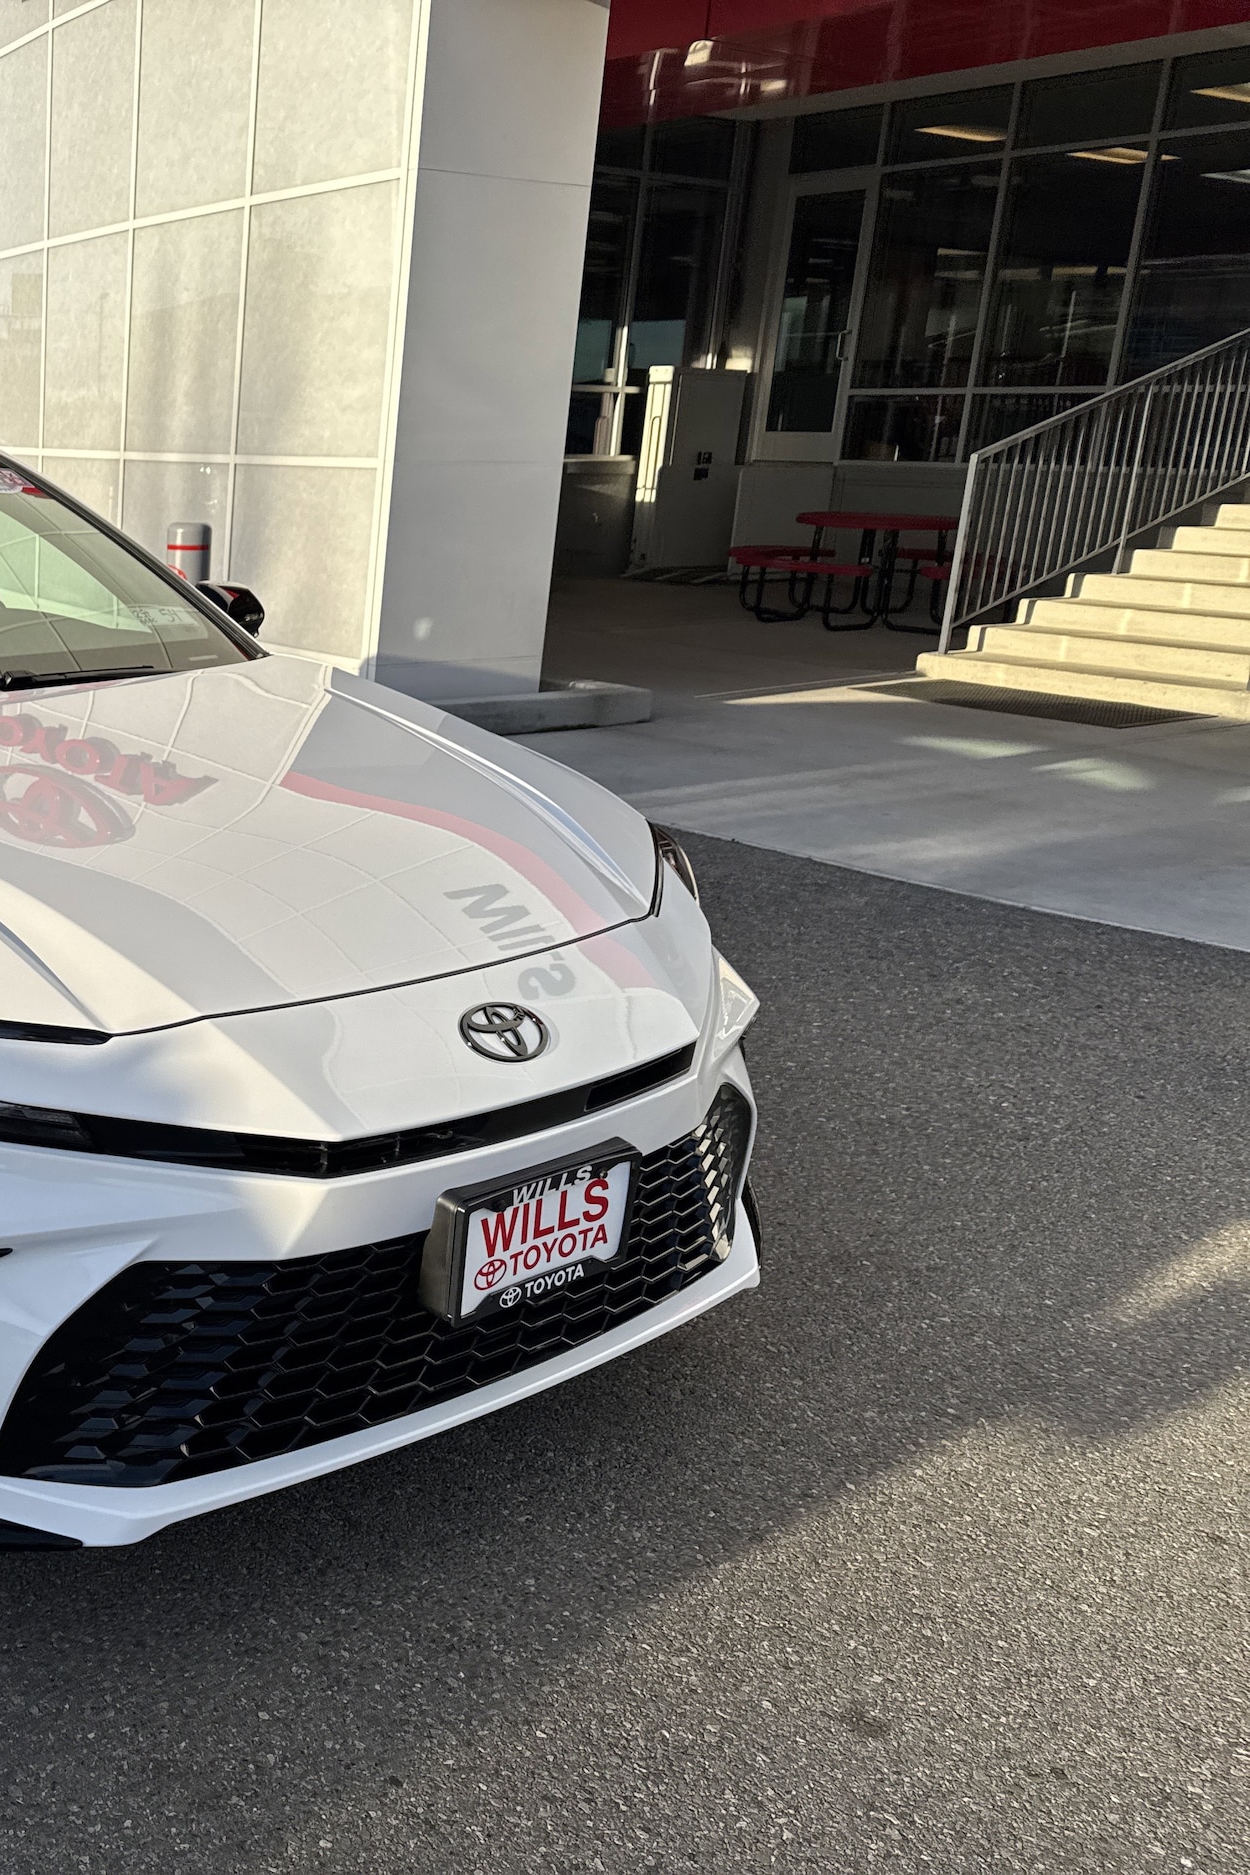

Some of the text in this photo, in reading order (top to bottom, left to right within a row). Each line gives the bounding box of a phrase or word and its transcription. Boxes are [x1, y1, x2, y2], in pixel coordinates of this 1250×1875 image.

[513, 1165, 592, 1203] WILLS
[481, 1178, 609, 1258] WILLS
[509, 1224, 608, 1276] TOYOTA
[525, 1263, 584, 1297] TOYOTA
